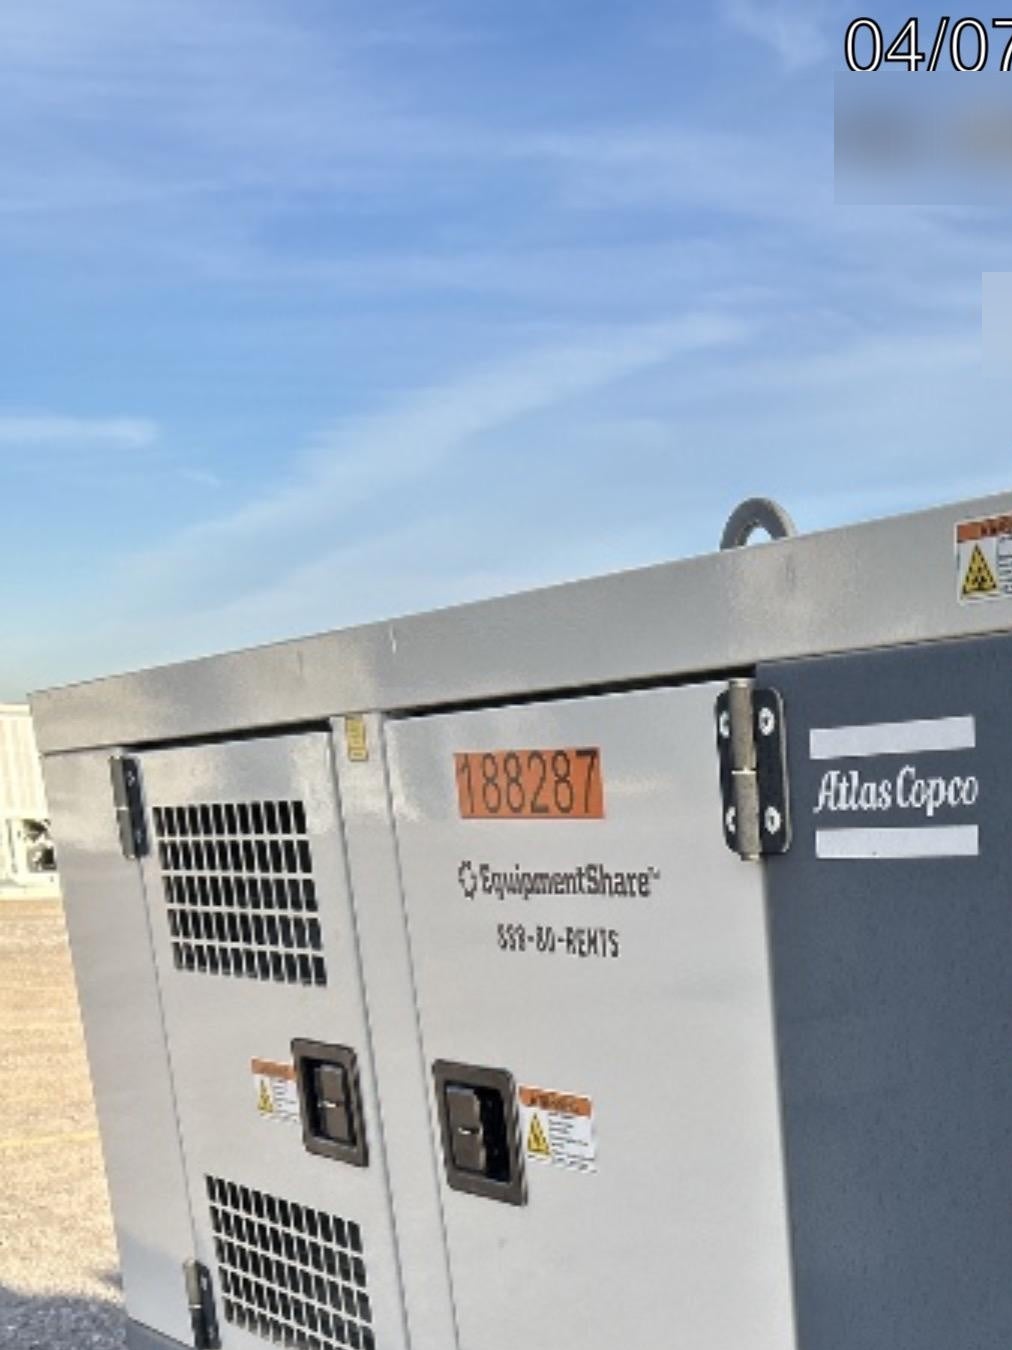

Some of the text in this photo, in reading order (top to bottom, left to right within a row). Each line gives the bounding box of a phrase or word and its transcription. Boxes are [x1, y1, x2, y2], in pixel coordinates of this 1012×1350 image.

[460, 749, 599, 814] 188287
[812, 764, 979, 817] Atlas Copco
